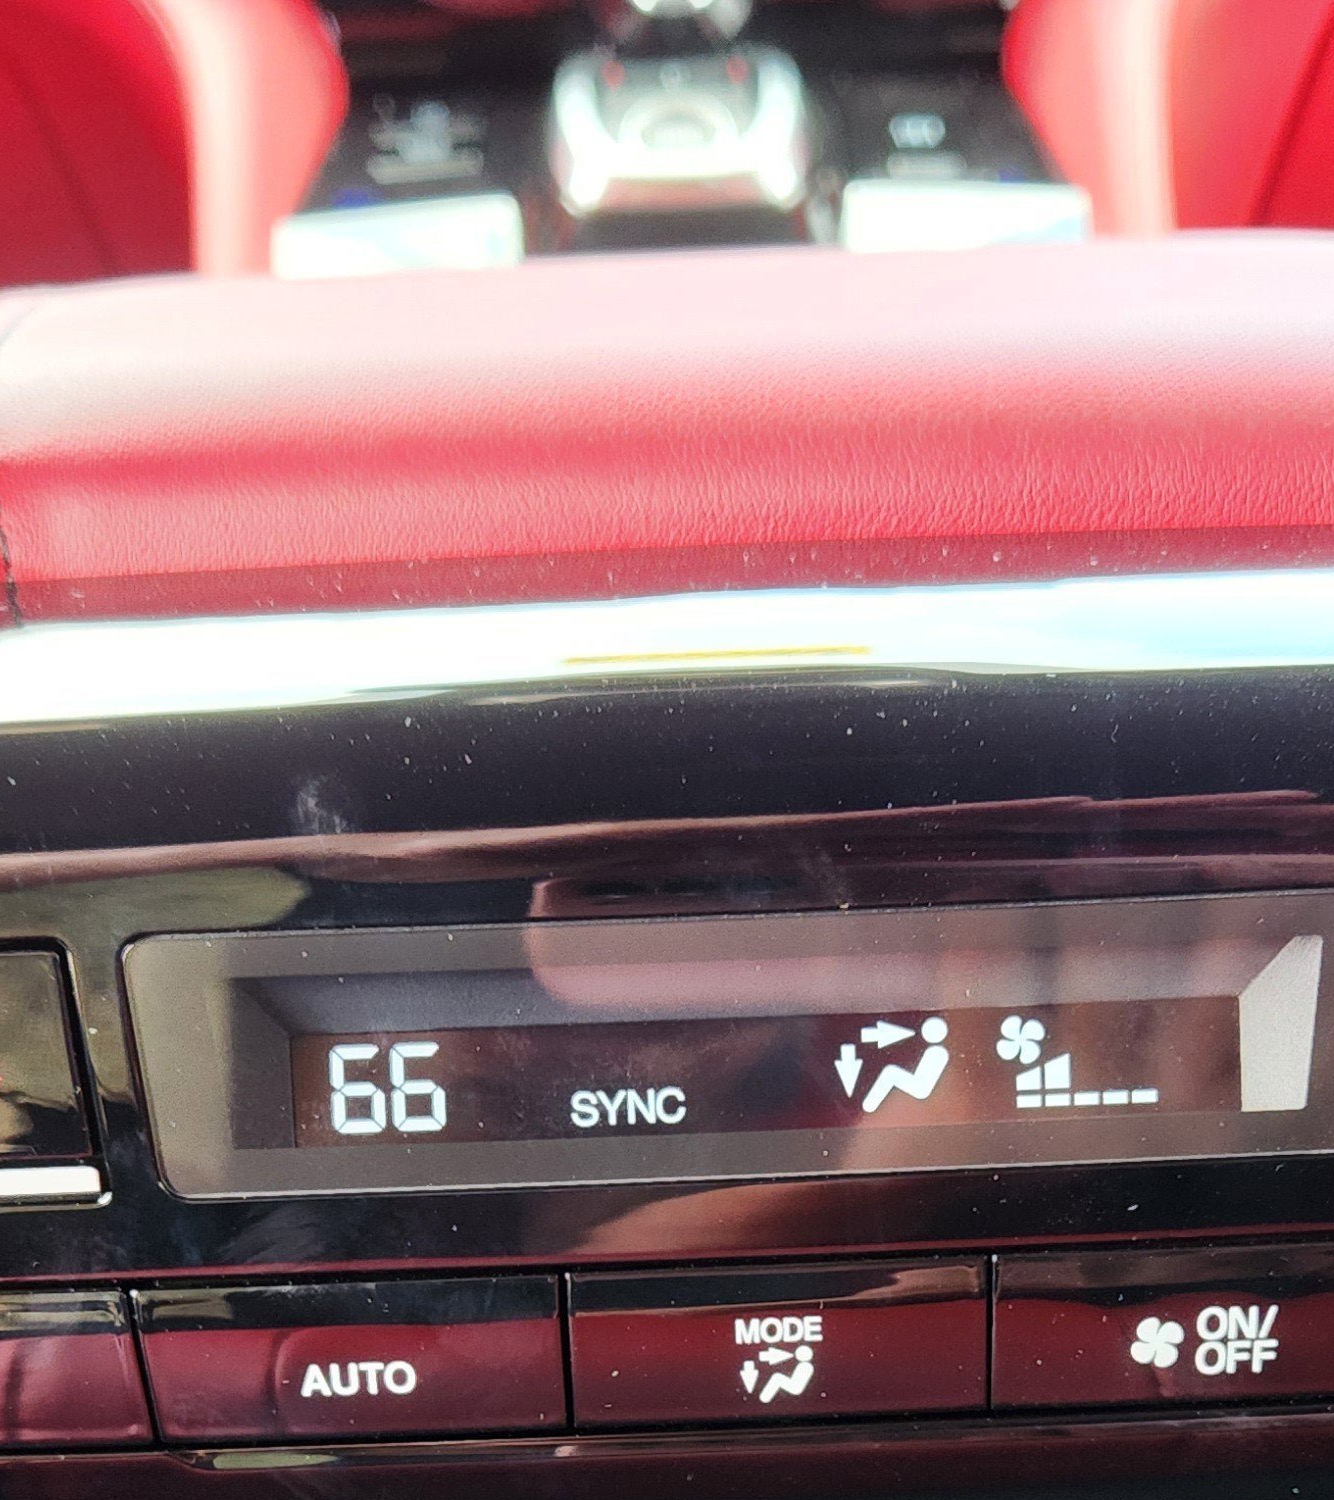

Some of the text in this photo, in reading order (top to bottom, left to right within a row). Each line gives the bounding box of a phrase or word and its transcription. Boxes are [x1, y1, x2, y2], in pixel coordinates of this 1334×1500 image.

[328, 1041, 447, 1136] 66
[569, 1085, 688, 1128] SYNC
[733, 1315, 824, 1345] MODE
[1195, 1304, 1280, 1341] ON/
[1194, 1338, 1280, 1376] OFF
[300, 1360, 417, 1399] AUTO
